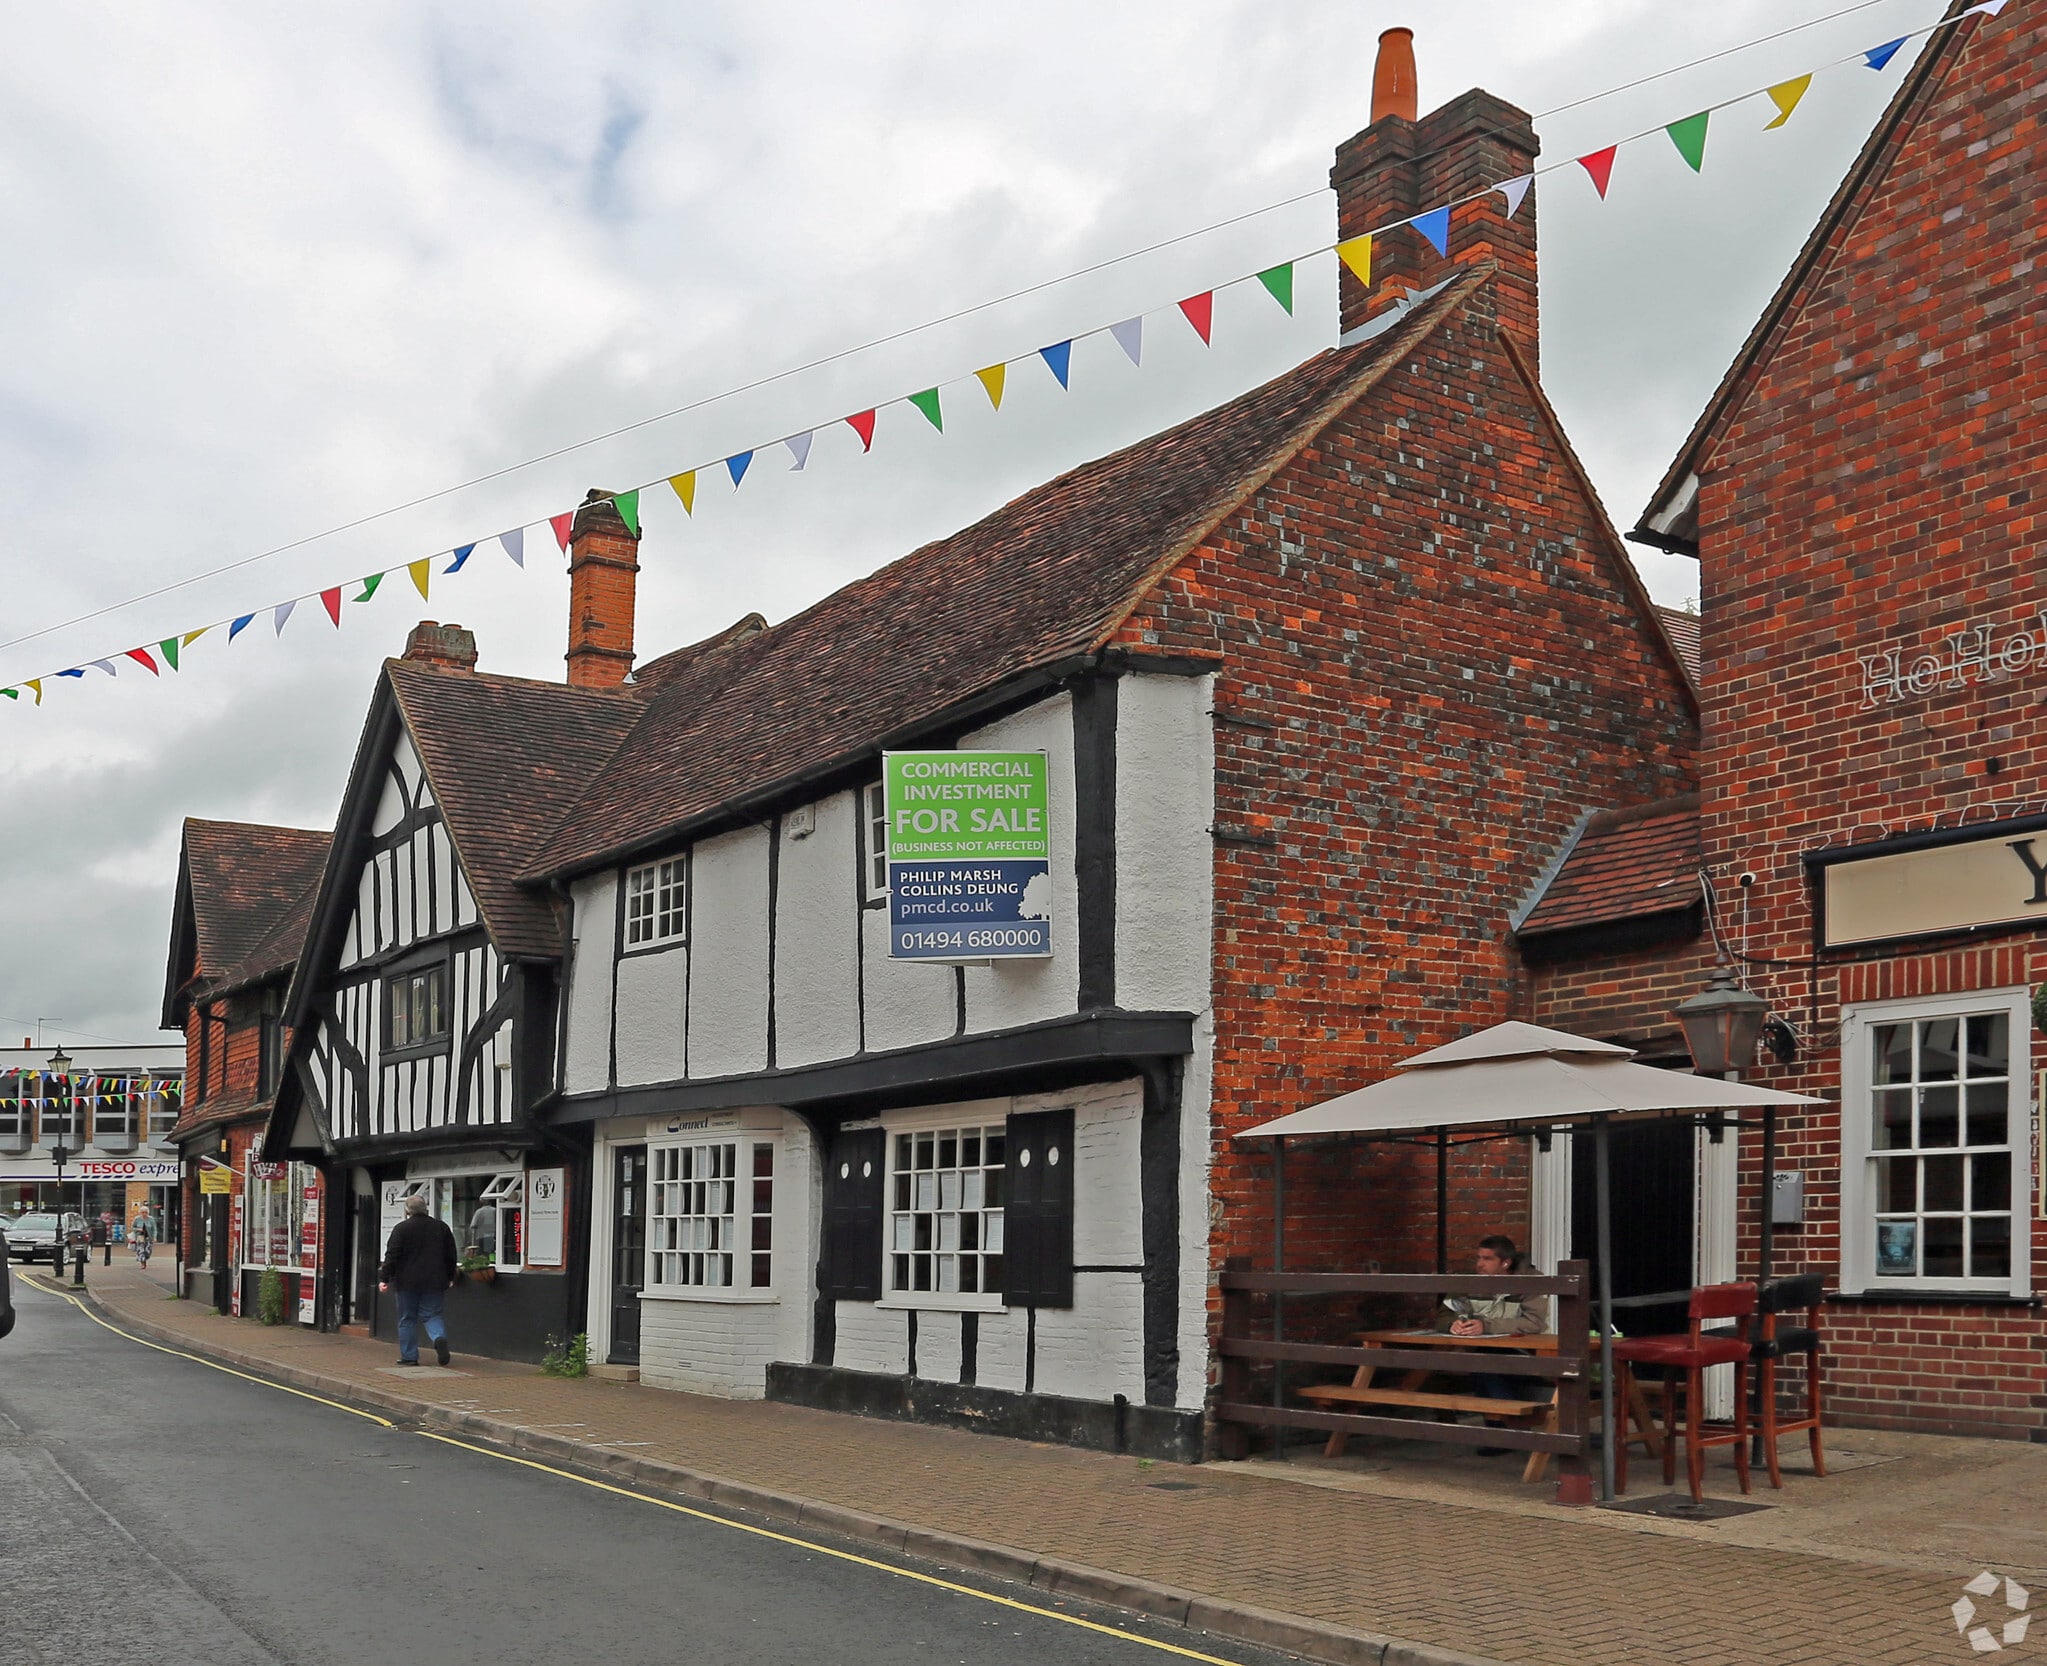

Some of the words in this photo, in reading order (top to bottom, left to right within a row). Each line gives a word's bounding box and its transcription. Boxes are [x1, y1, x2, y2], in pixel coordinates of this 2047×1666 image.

[901, 762, 1034, 778] COMMERCIAL
[904, 784, 1032, 801] INVESTMENT
[896, 808, 960, 834] FOR
[970, 808, 1041, 832] SALE
[892, 842, 953, 855] (BUSINESS
[956, 841, 983, 851] NOT
[985, 840, 1045, 852] AFFECTED)
[900, 871, 945, 883] PHILIP
[950, 870, 1001, 881] MARSH
[900, 885, 962, 896] COLLINS
[967, 883, 1019, 895] DEUNG
[901, 898, 994, 918] pmcd.co.uk
[901, 931, 963, 949] 01494
[968, 929, 1041, 947] 680000
[80, 1163, 136, 1174] TESCO
